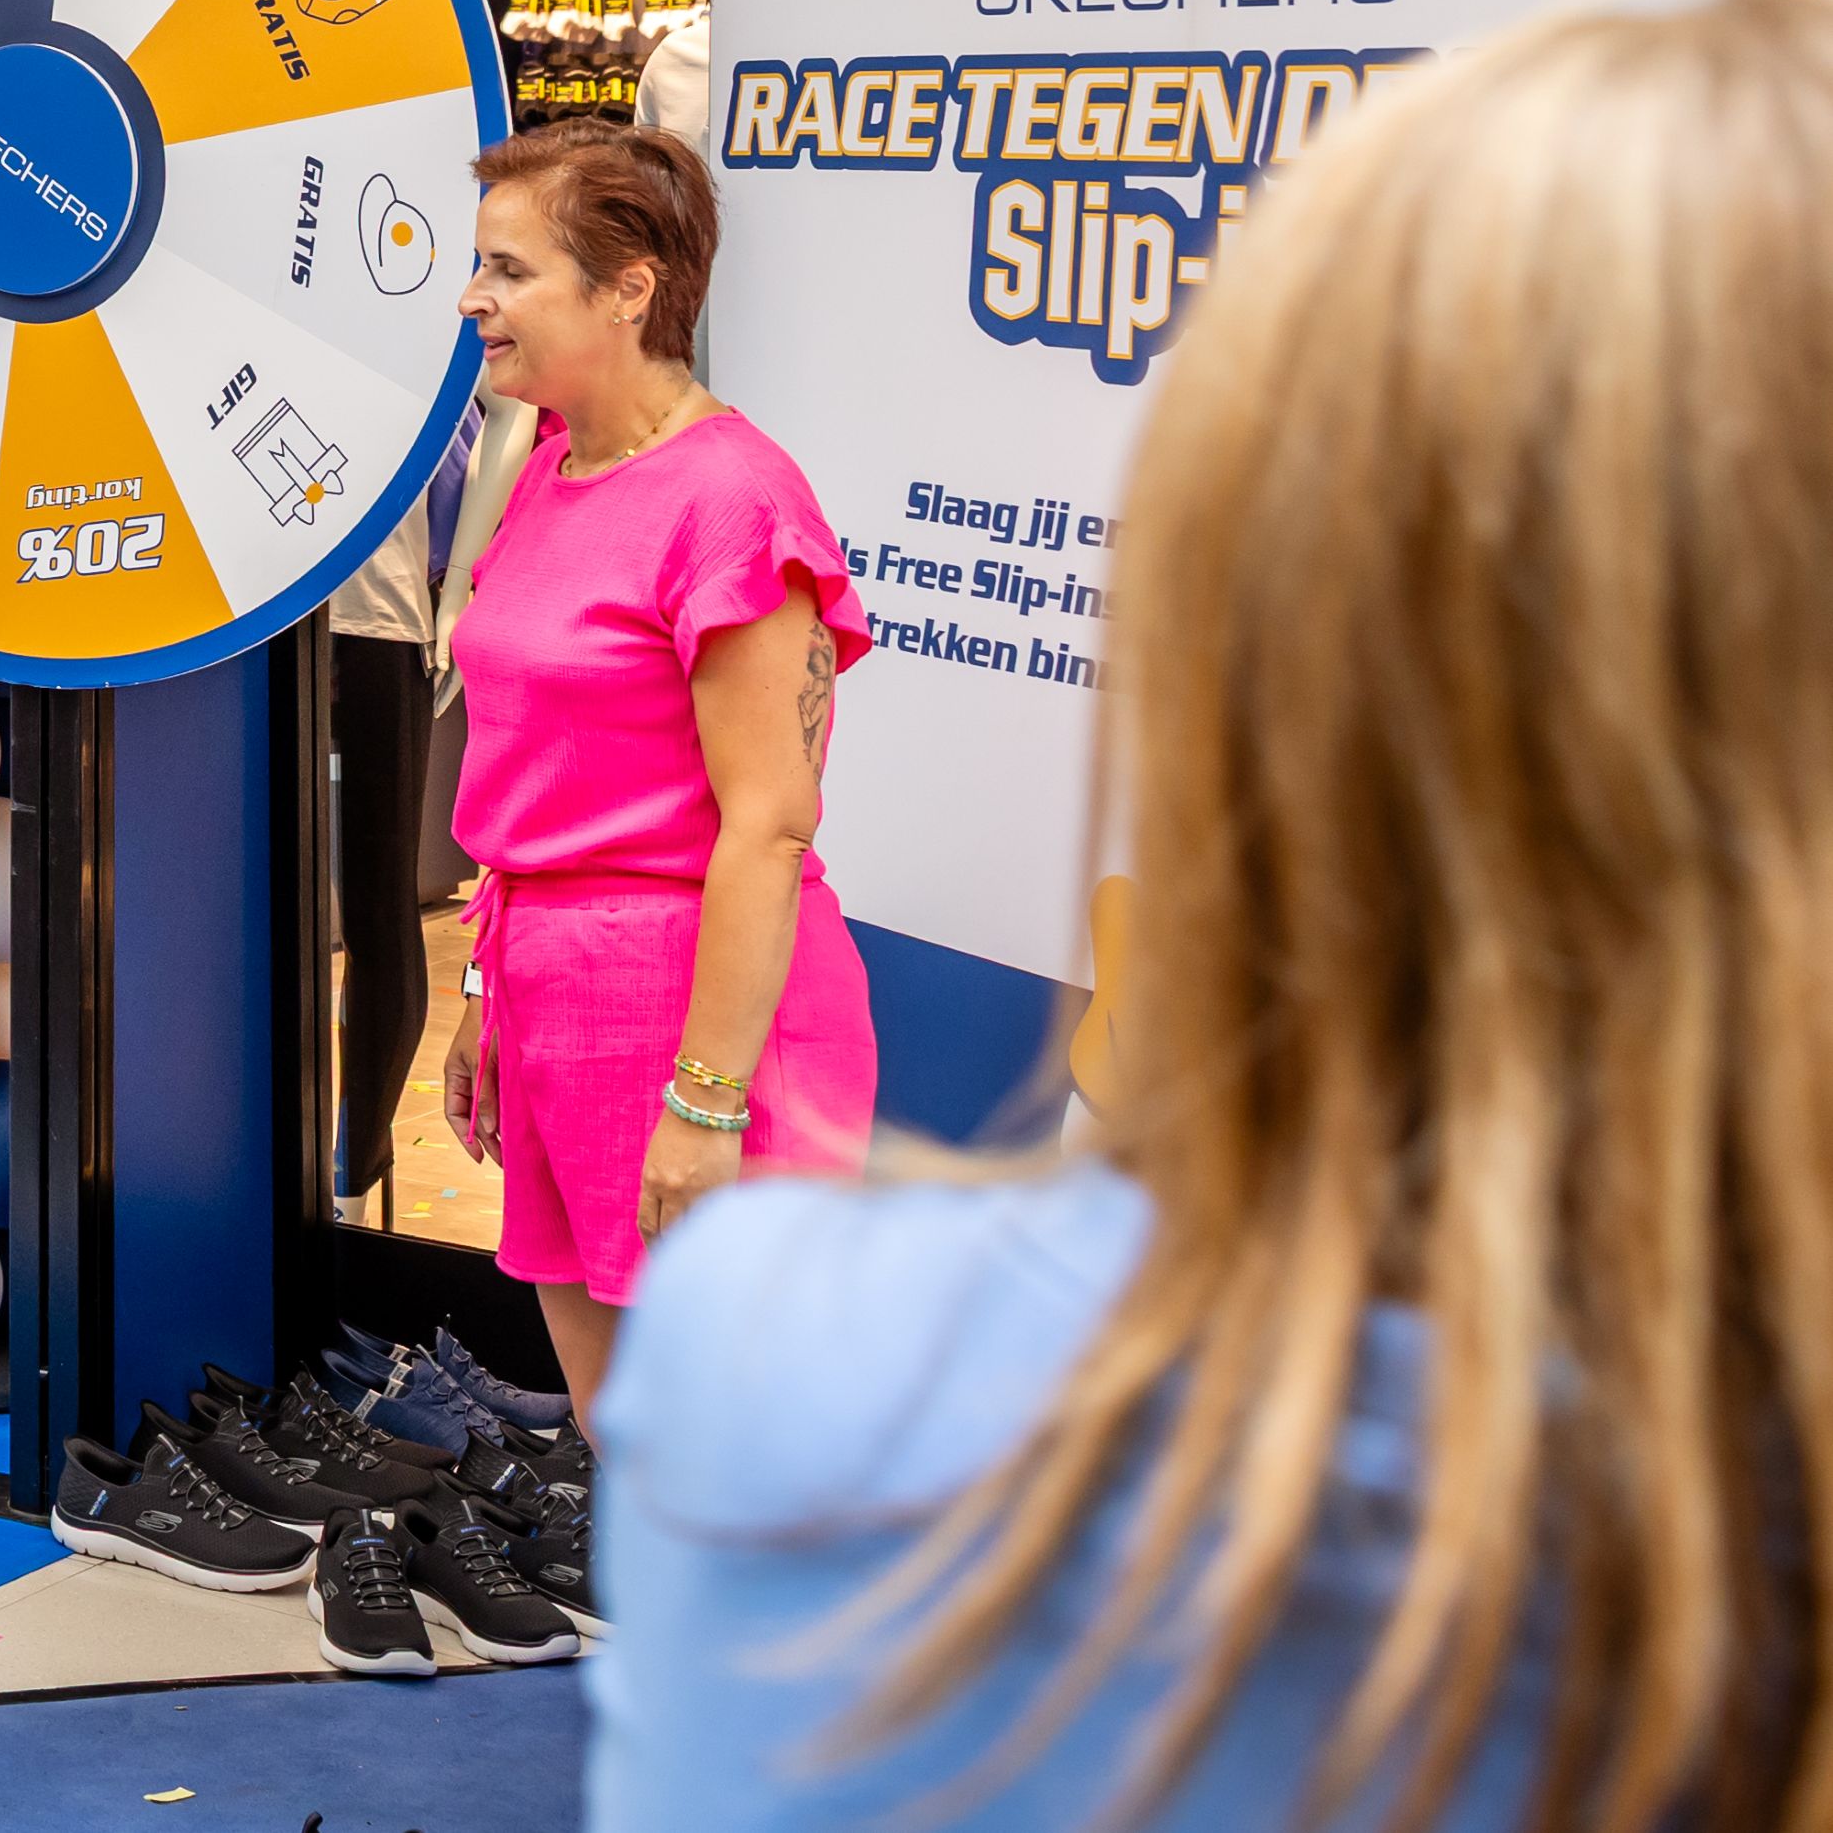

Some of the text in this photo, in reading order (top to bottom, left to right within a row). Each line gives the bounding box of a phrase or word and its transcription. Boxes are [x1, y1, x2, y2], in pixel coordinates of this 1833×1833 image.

[728, 68, 944, 158] RACE
[958, 64, 1261, 164] TEGEN
[290, 155, 324, 288] GRATIS
[206, 363, 257, 430] GIFT
[26, 477, 144, 511] korting
[905, 481, 1019, 544] Slaag
[1019, 498, 1071, 552] jij
[17, 512, 166, 584] 20%
[875, 543, 963, 594] Free
